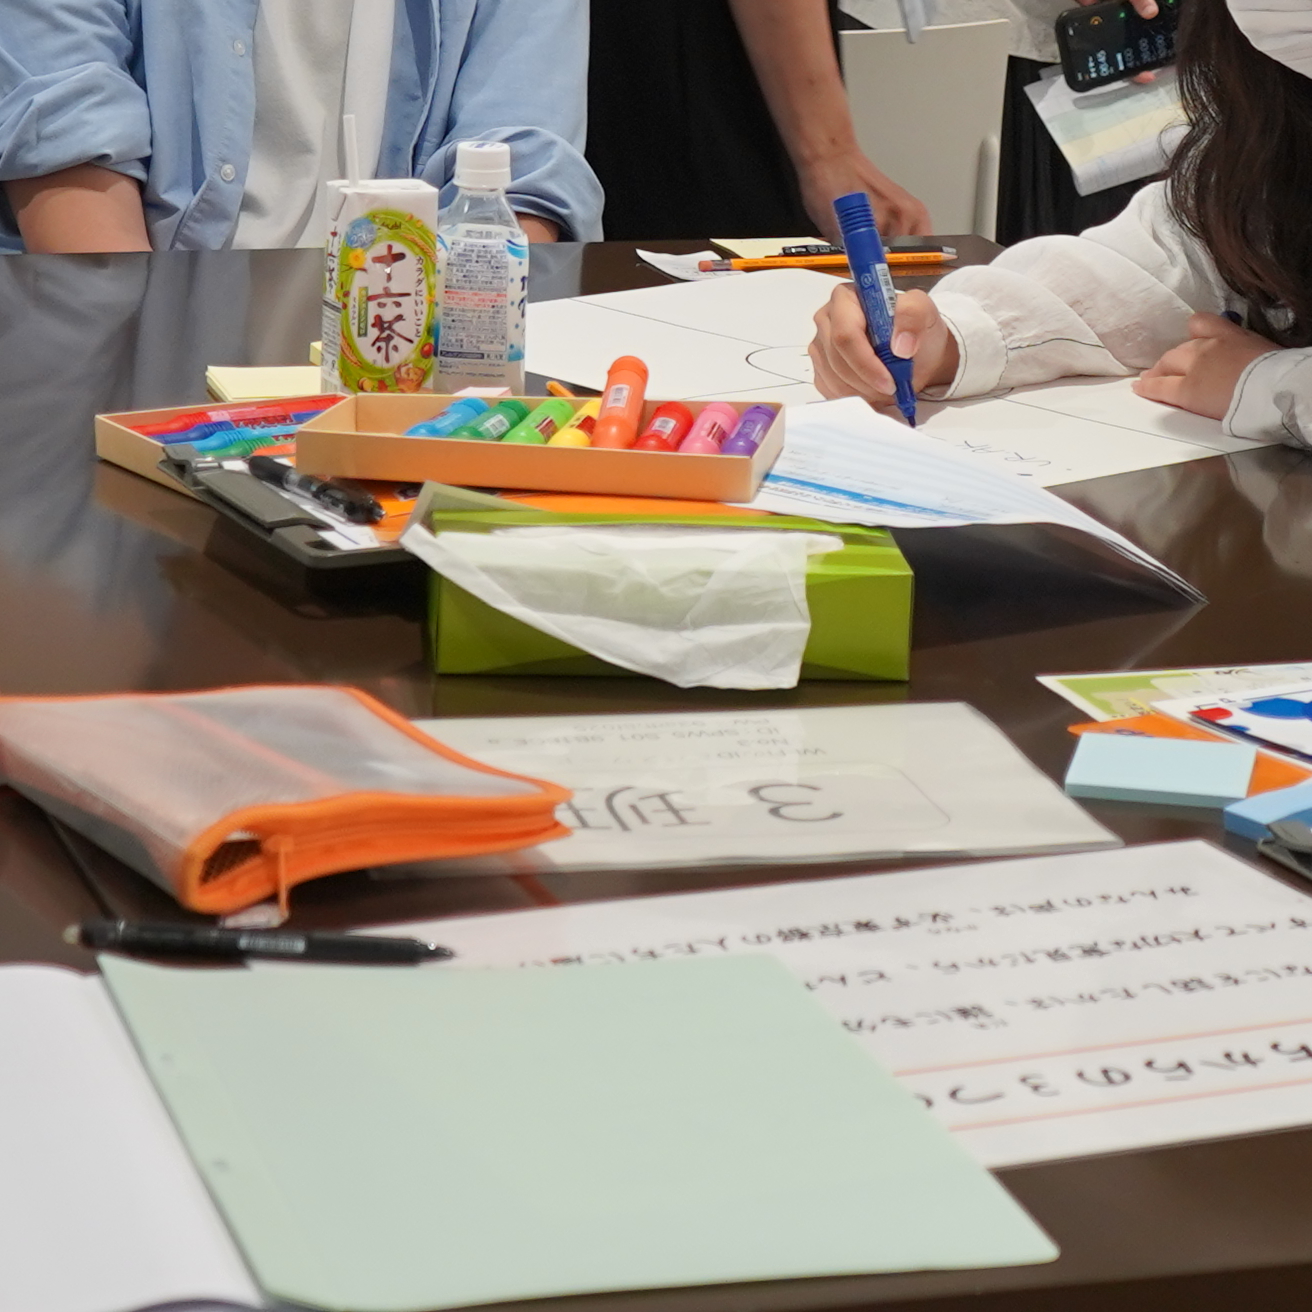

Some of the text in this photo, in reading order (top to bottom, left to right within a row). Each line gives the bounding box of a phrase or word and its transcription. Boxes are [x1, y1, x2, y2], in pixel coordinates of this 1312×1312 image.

[366, 243, 415, 364] 十六茶
[414, 255, 425, 338] カラダにいいこと
